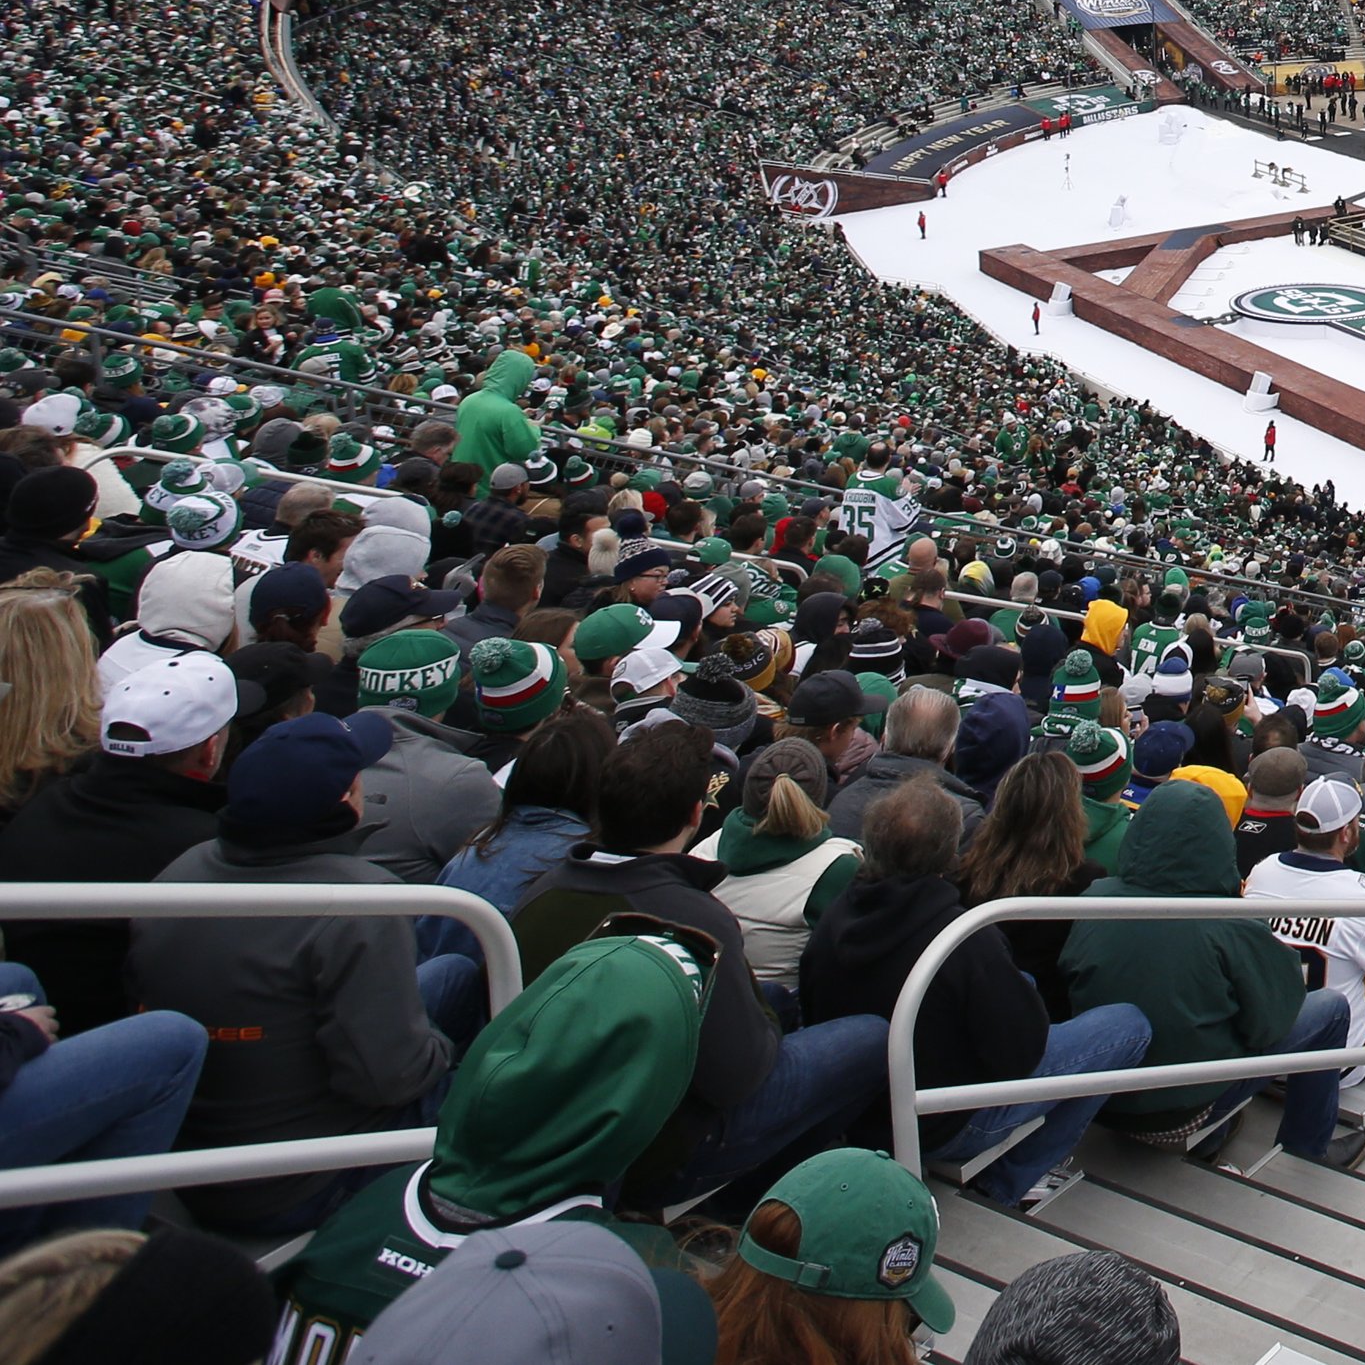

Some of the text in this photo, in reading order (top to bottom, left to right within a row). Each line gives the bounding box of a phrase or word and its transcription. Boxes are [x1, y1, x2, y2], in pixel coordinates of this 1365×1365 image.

[1082, 105, 1139, 125] DALLAS STARS
[889, 148, 931, 173] HAPPY
[925, 134, 965, 154] NEW
[962, 118, 1012, 139] YEAR
[843, 504, 877, 543] 35
[377, 1246, 436, 1277] KOH
[887, 1245, 920, 1263] Winter
